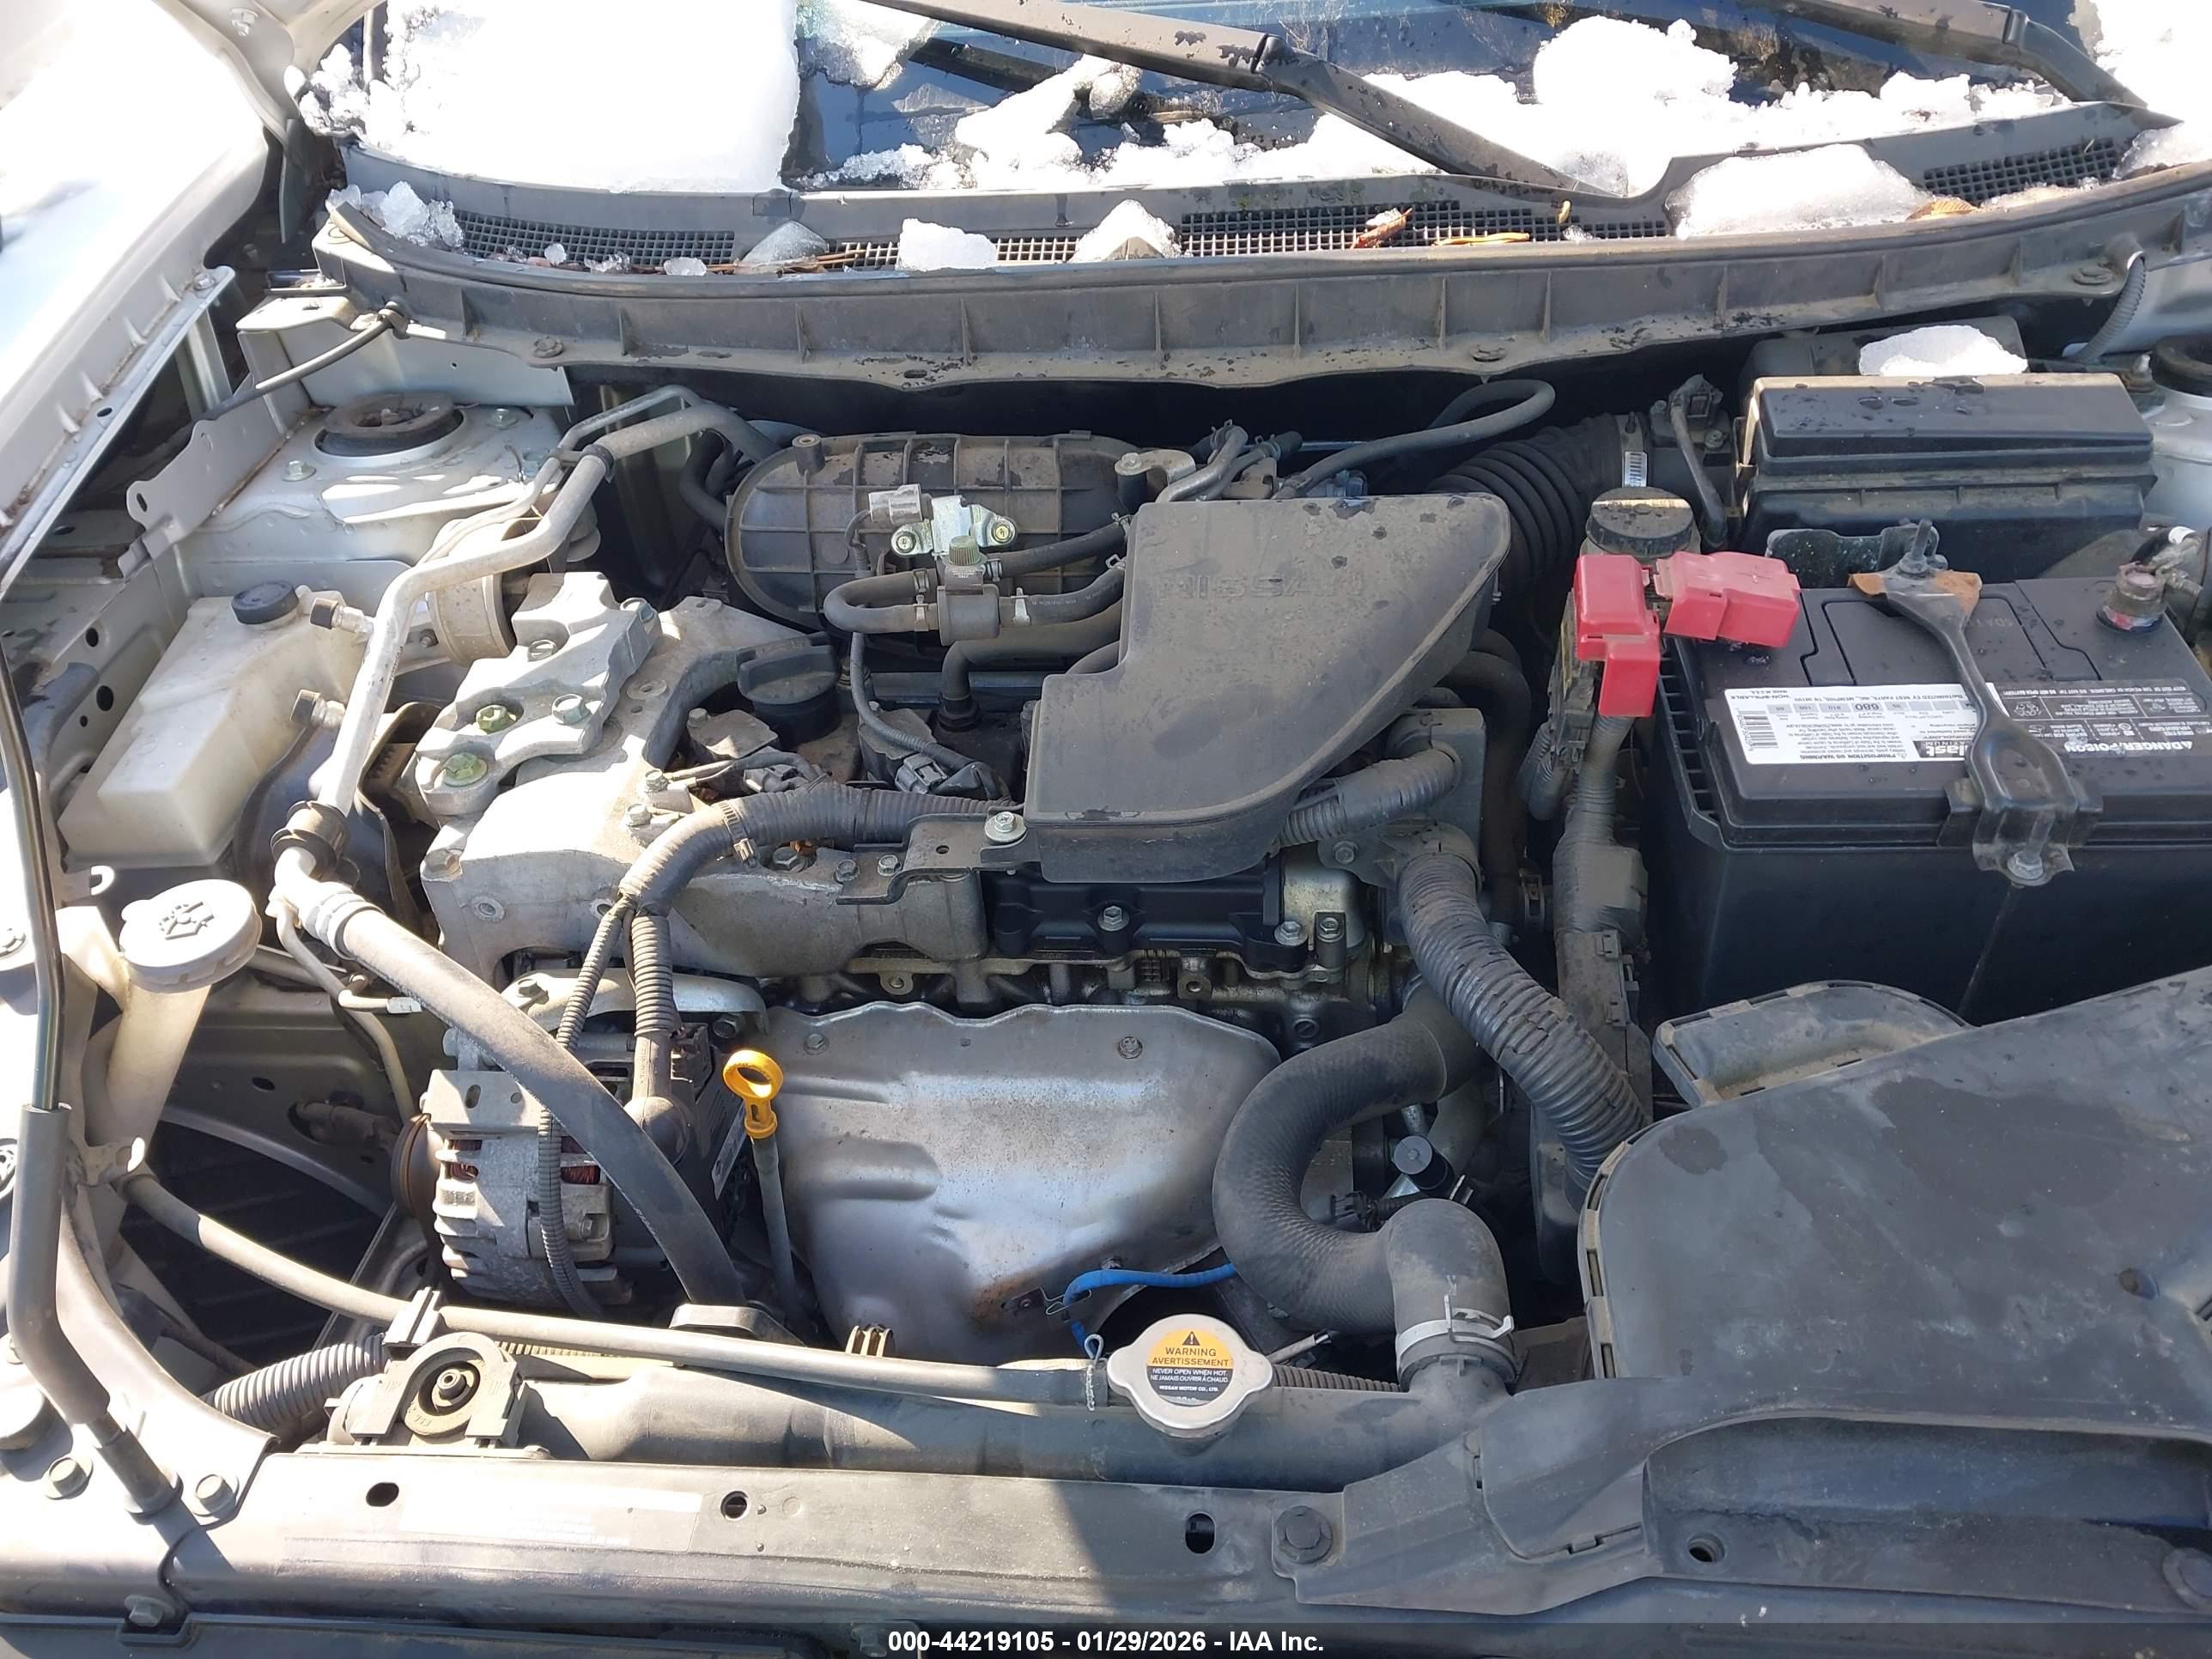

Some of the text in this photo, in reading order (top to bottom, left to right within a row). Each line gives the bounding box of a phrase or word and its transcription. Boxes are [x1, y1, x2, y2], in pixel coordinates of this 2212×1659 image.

[1156, 575, 1363, 599] NISSAN
[1165, 1347, 1216, 1357] WARNING
[1152, 1357, 1230, 1367] AVERTISSEMENT
